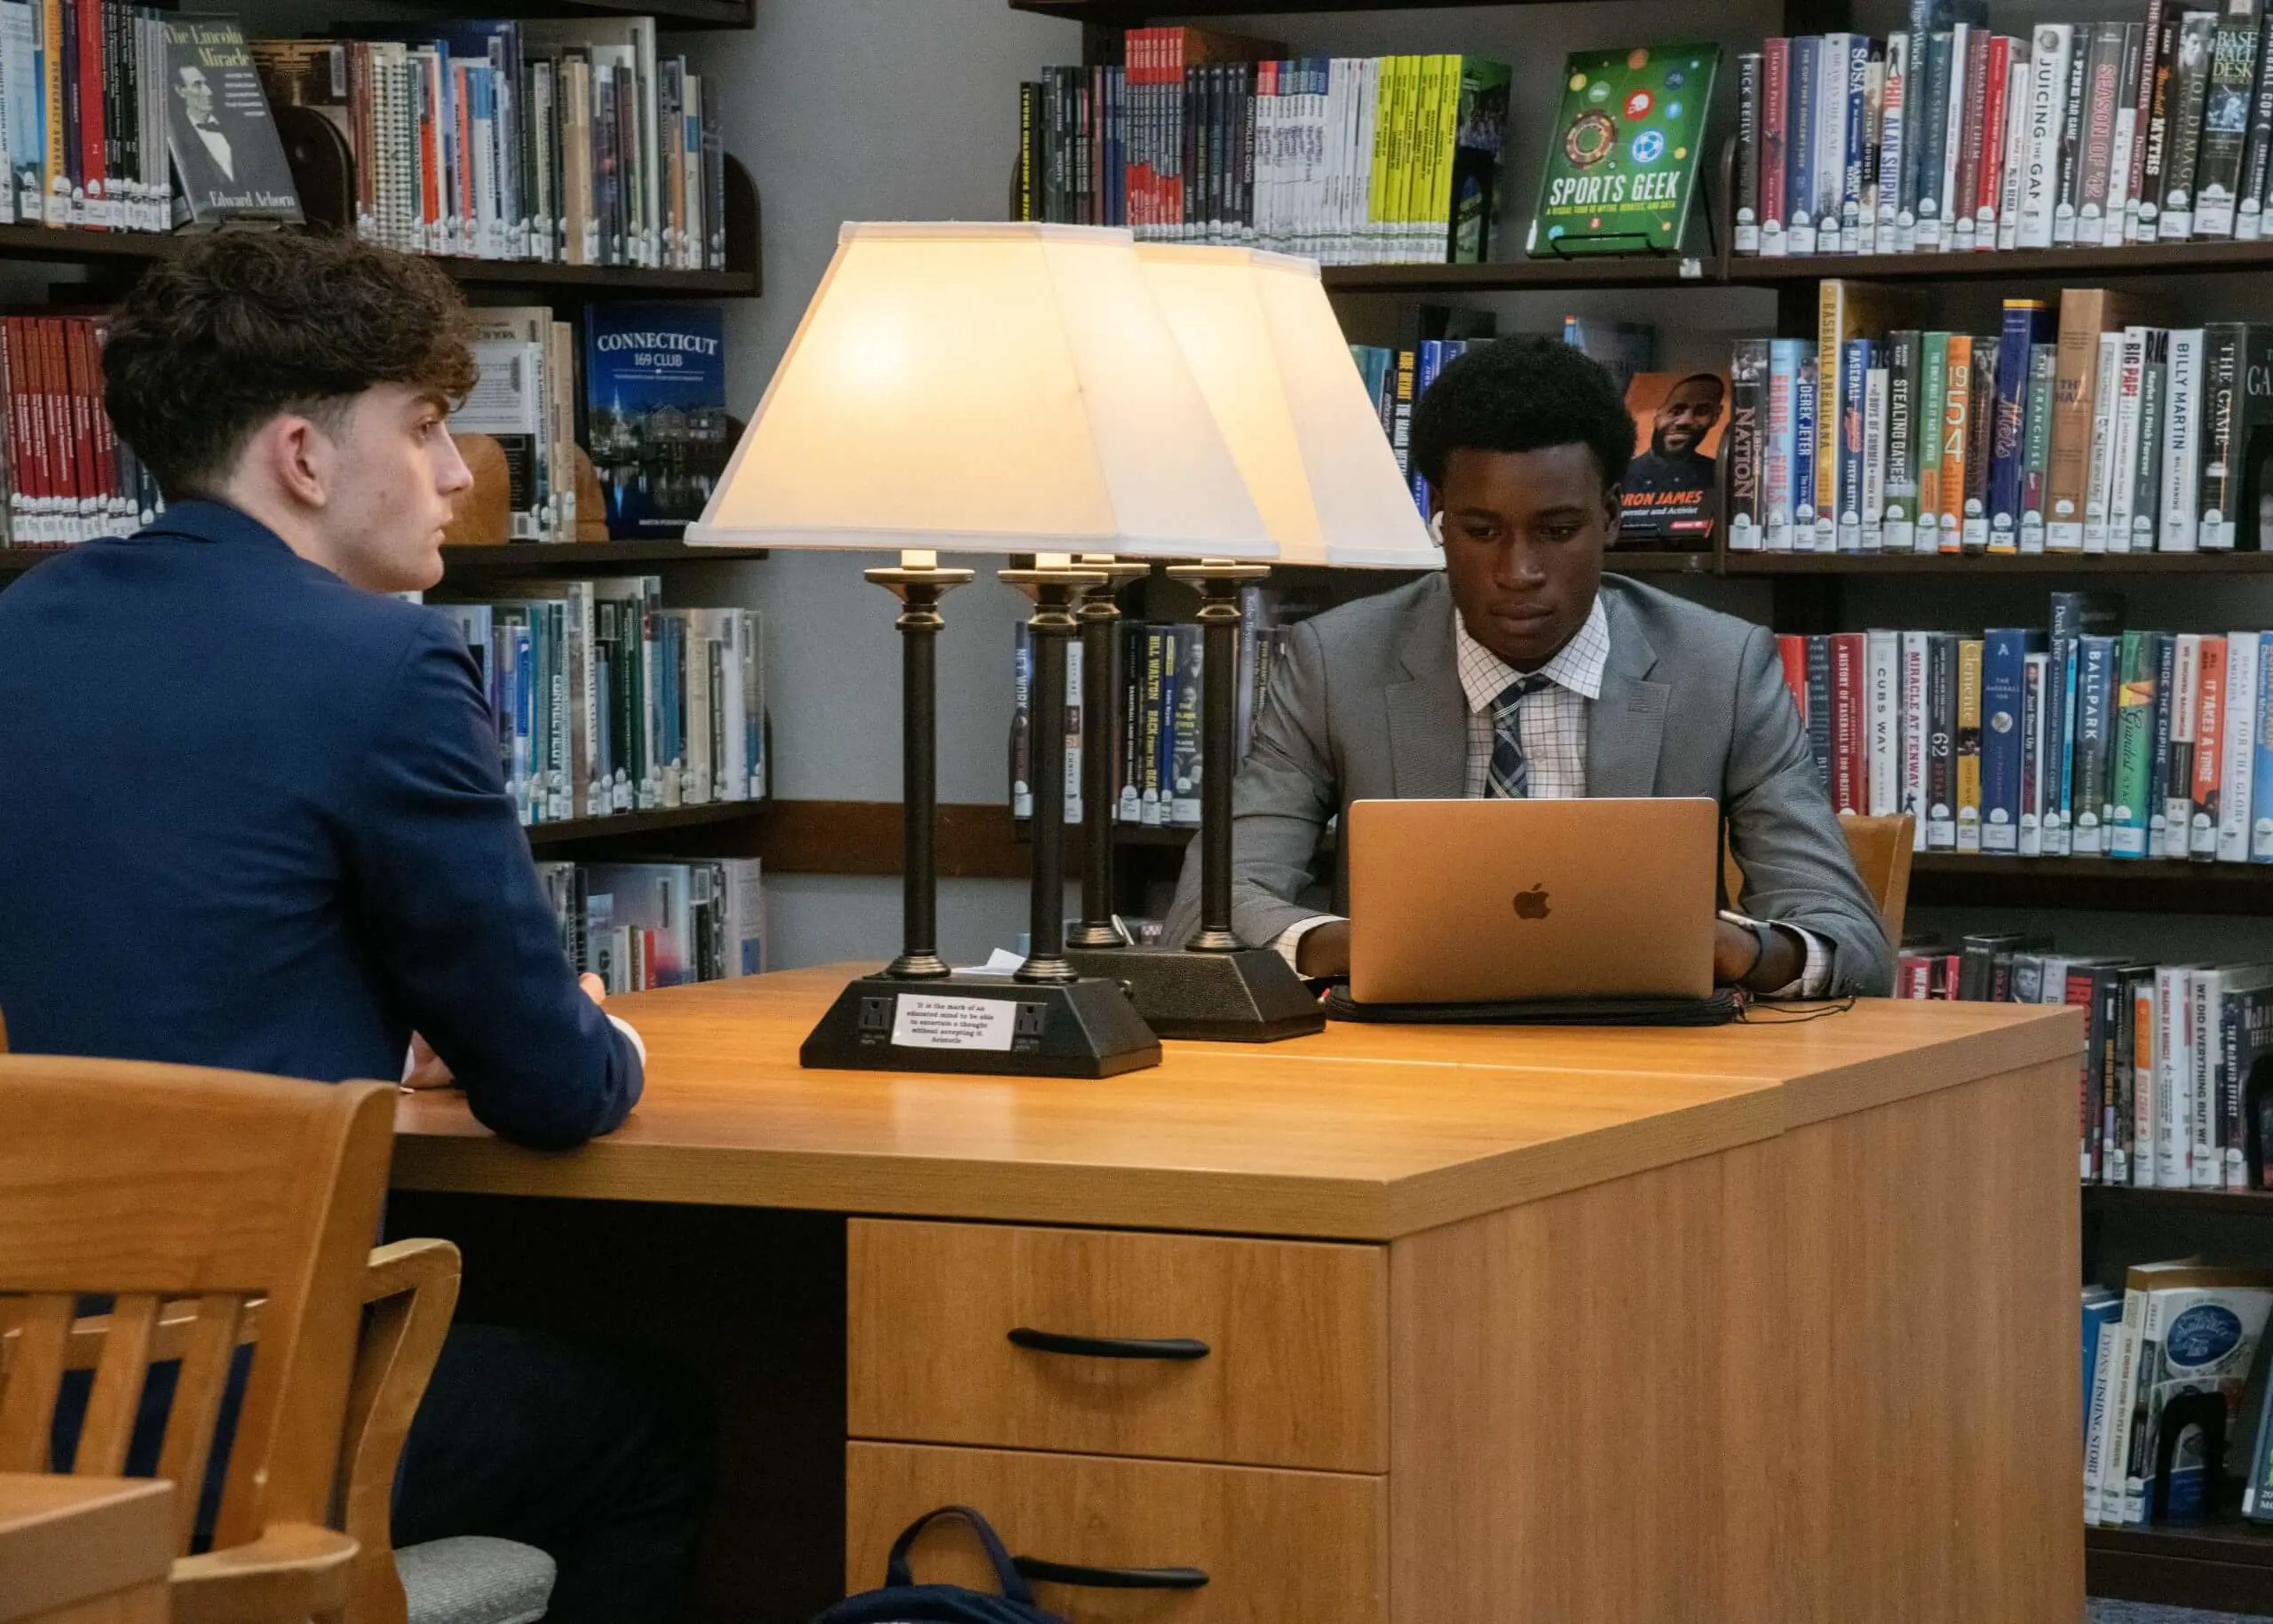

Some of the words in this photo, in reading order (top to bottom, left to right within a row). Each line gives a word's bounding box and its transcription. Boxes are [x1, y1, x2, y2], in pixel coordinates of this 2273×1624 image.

[2149, 0, 2162, 22] THE
[190, 25, 243, 44] Lincoln
[2143, 23, 2158, 61] NEGRO
[2216, 30, 2259, 47] BASE
[198, 47, 249, 67] Miracle
[1910, 32, 1923, 70] Woods
[1980, 44, 1989, 59] US
[2214, 47, 2256, 62] BALL
[1741, 64, 1752, 94] RICK
[1849, 48, 1867, 94] SOSA
[2071, 59, 2084, 97] PINE
[2139, 61, 2153, 109] LEAGUES
[2213, 62, 2253, 78] DESK
[1882, 75, 1902, 108] PHIL
[1975, 64, 1987, 117] AGAINST
[2033, 58, 2052, 139] JUICING
[2091, 63, 2117, 138] SEASON
[2190, 73, 2206, 105] JOE
[2260, 92, 2272, 117] COP
[1741, 101, 1752, 144] REILLY
[2069, 99, 2081, 115] TAR
[1882, 117, 1900, 153] ALAN
[1972, 124, 1983, 160] THEM
[2067, 117, 2078, 141] GAME
[2087, 142, 2110, 167] OF
[2145, 117, 2166, 176] MYTHS
[210, 190, 252, 207] Edward
[1549, 174, 1627, 205] SPORTS
[1631, 170, 1681, 201] GEEK
[598, 332, 717, 355] CONNECTICUT
[1821, 302, 1835, 368] BASEBALL
[635, 353, 652, 366] 169
[653, 353, 683, 367] CLUB
[1398, 352, 1414, 370] KOBE
[2036, 354, 2046, 379] THE
[2123, 343, 2141, 364] BIG
[2175, 343, 2190, 387] BILLY
[2219, 343, 2234, 384] THE
[1398, 372, 1413, 400] BRYANT
[1849, 350, 1862, 401] BASEBALL
[2120, 368, 2140, 398] PAPI
[2145, 370, 2156, 400] Maybe
[1396, 404, 1412, 416] THE
[1798, 385, 1813, 419] DEREK
[1820, 373, 1833, 449] AMERICANA
[1870, 397, 1879, 417] BOYS
[1891, 379, 1908, 439] STEALING
[2145, 403, 2156, 414] I'll
[2214, 389, 2232, 446] GAME
[1394, 418, 1410, 447] MAMBA
[1869, 421, 1879, 430] OF
[1996, 392, 2024, 458] Mets
[2031, 388, 2044, 467] FRANCHISE
[2142, 416, 2153, 439] Pitch
[2172, 392, 2188, 450] MARTIN
[1733, 406, 1755, 499] NATION
[1797, 424, 1813, 456] JETER
[1867, 433, 1878, 468] SUMMER
[1889, 441, 1905, 483] GAMES
[2141, 441, 2151, 476] Forever
[1620, 492, 1655, 506] RON
[1655, 490, 1703, 504] JAMES
[2053, 606, 2066, 636] Derek
[1015, 648, 1027, 673] NET
[1149, 636, 1160, 656] BILL
[2051, 638, 2064, 661] Jeter
[1148, 659, 1160, 700] WALTON
[1839, 653, 1849, 688] HISTORY
[1909, 652, 1921, 709] MIRACLE
[1962, 643, 1979, 721] Clemente
[2160, 646, 2173, 686] INSIDE
[1016, 675, 1027, 709] WORK
[1839, 690, 1849, 701] OF
[1877, 667, 1886, 714] CUBS
[2085, 651, 2102, 741] BALLPARK
[2205, 678, 2217, 692] IT
[2026, 693, 2035, 712] Just
[2160, 693, 2170, 717] THE
[2201, 693, 2216, 733] TAKES
[551, 674, 563, 764] CONNECTICUT
[1146, 709, 1158, 734] BACK
[1839, 703, 1849, 743] BASEBALL
[1909, 715, 1920, 732] AT
[2026, 714, 2035, 735] Show
[2237, 720, 2249, 746] FOR
[1840, 745, 1849, 754] IN
[1877, 721, 1886, 755] WAY
[1932, 732, 1949, 757] 62
[2024, 737, 2035, 749] Up
[2120, 707, 2142, 772] Grandest
[2157, 719, 2168, 764] EMPIRE
[2201, 736, 2214, 746] A
[1839, 757, 1849, 770] 100
[1908, 735, 1920, 788] FENWAY
[2237, 752, 2247, 776] THE
[1839, 772, 1849, 808] OBJECTS
[2234, 782, 2245, 824] GLORY
[2196, 984, 2206, 1001] WE
[2196, 1004, 2206, 1024] DID
[2227, 1025, 2237, 1042] THE
[2196, 1026, 2206, 1098] EVERYTHING
[2196, 1101, 2206, 1123] BUT
[2227, 1084, 2238, 1117] EFFECT
[2099, 1333, 2112, 1374] LYONS
[2092, 1377, 2107, 1431] FISHING
